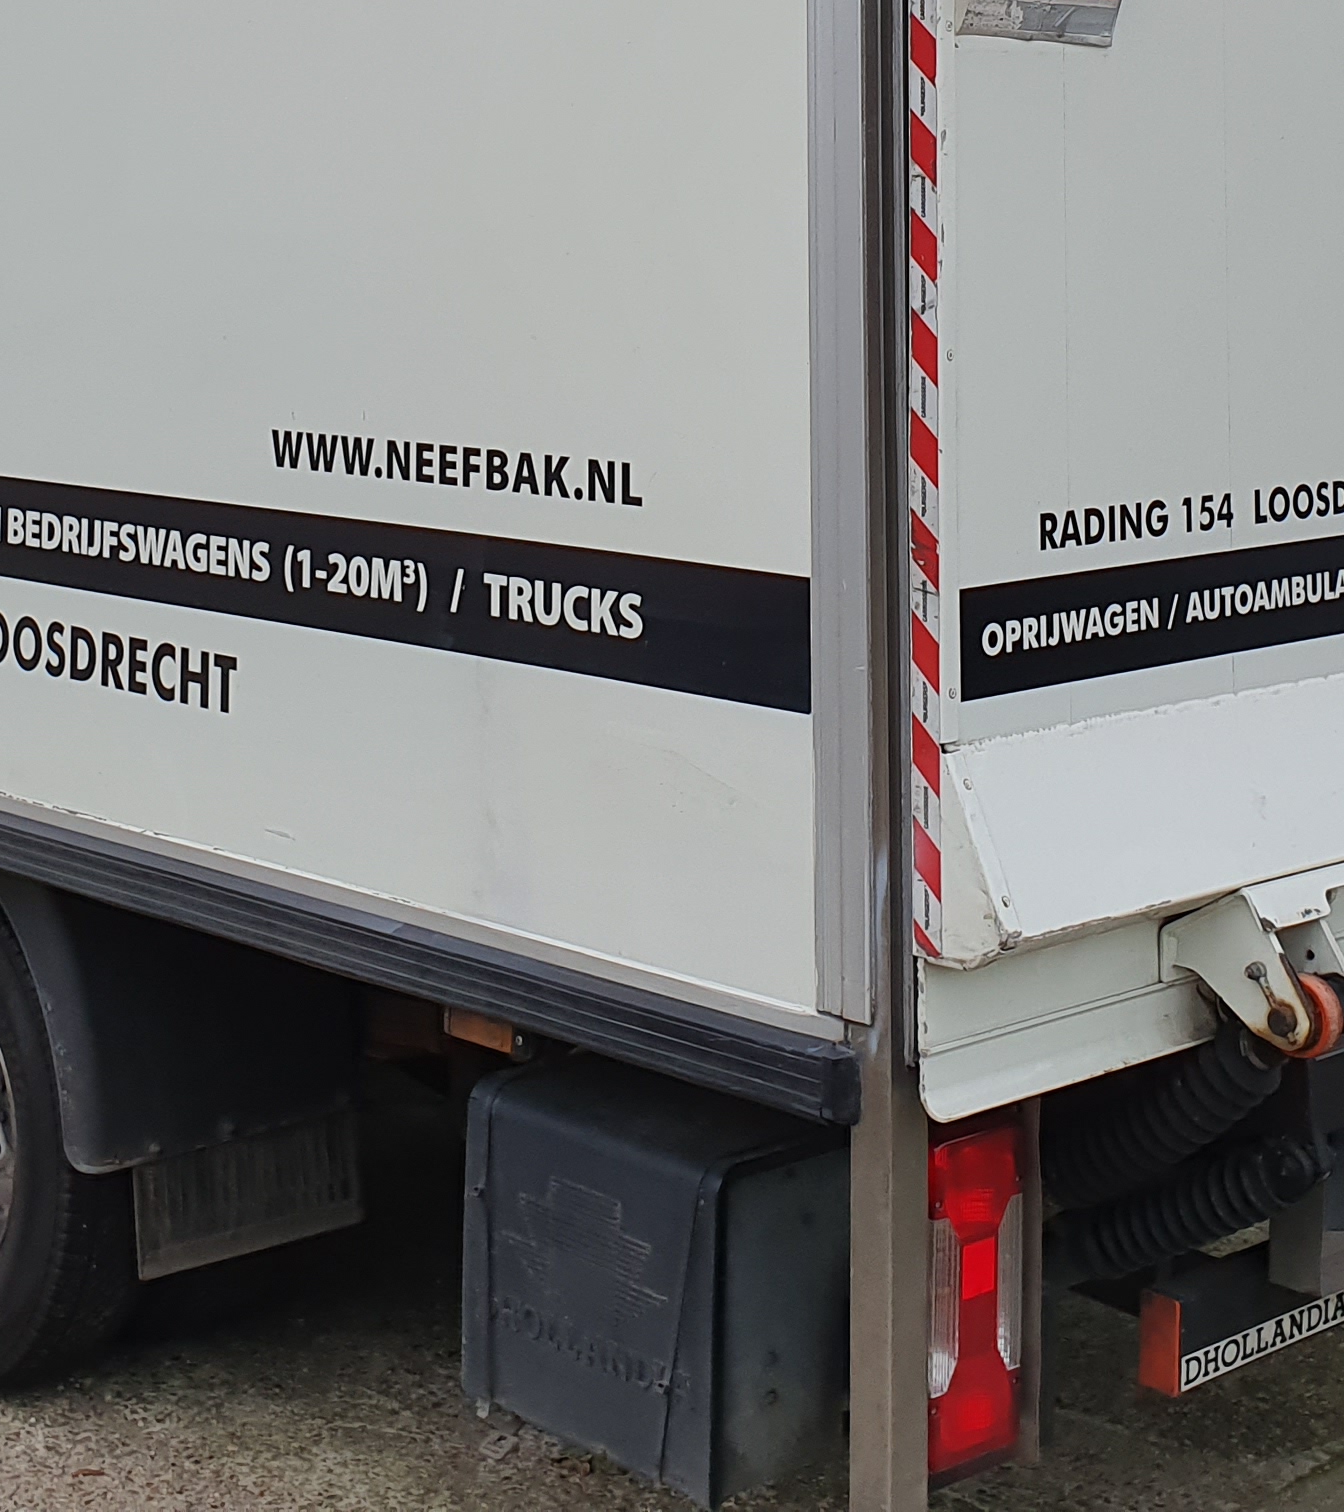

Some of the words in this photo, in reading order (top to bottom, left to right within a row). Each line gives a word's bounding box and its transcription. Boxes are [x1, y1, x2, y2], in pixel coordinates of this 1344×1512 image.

[272, 429, 643, 506] WWW.NEEFBAK.NL
[1039, 500, 1169, 551] RADING
[1181, 492, 1234, 533] 154
[7, 508, 271, 582] BEDRIJFSWAGENS
[483, 572, 644, 639] TRUCKS
[981, 597, 1159, 657] OPRIJWAGEN
